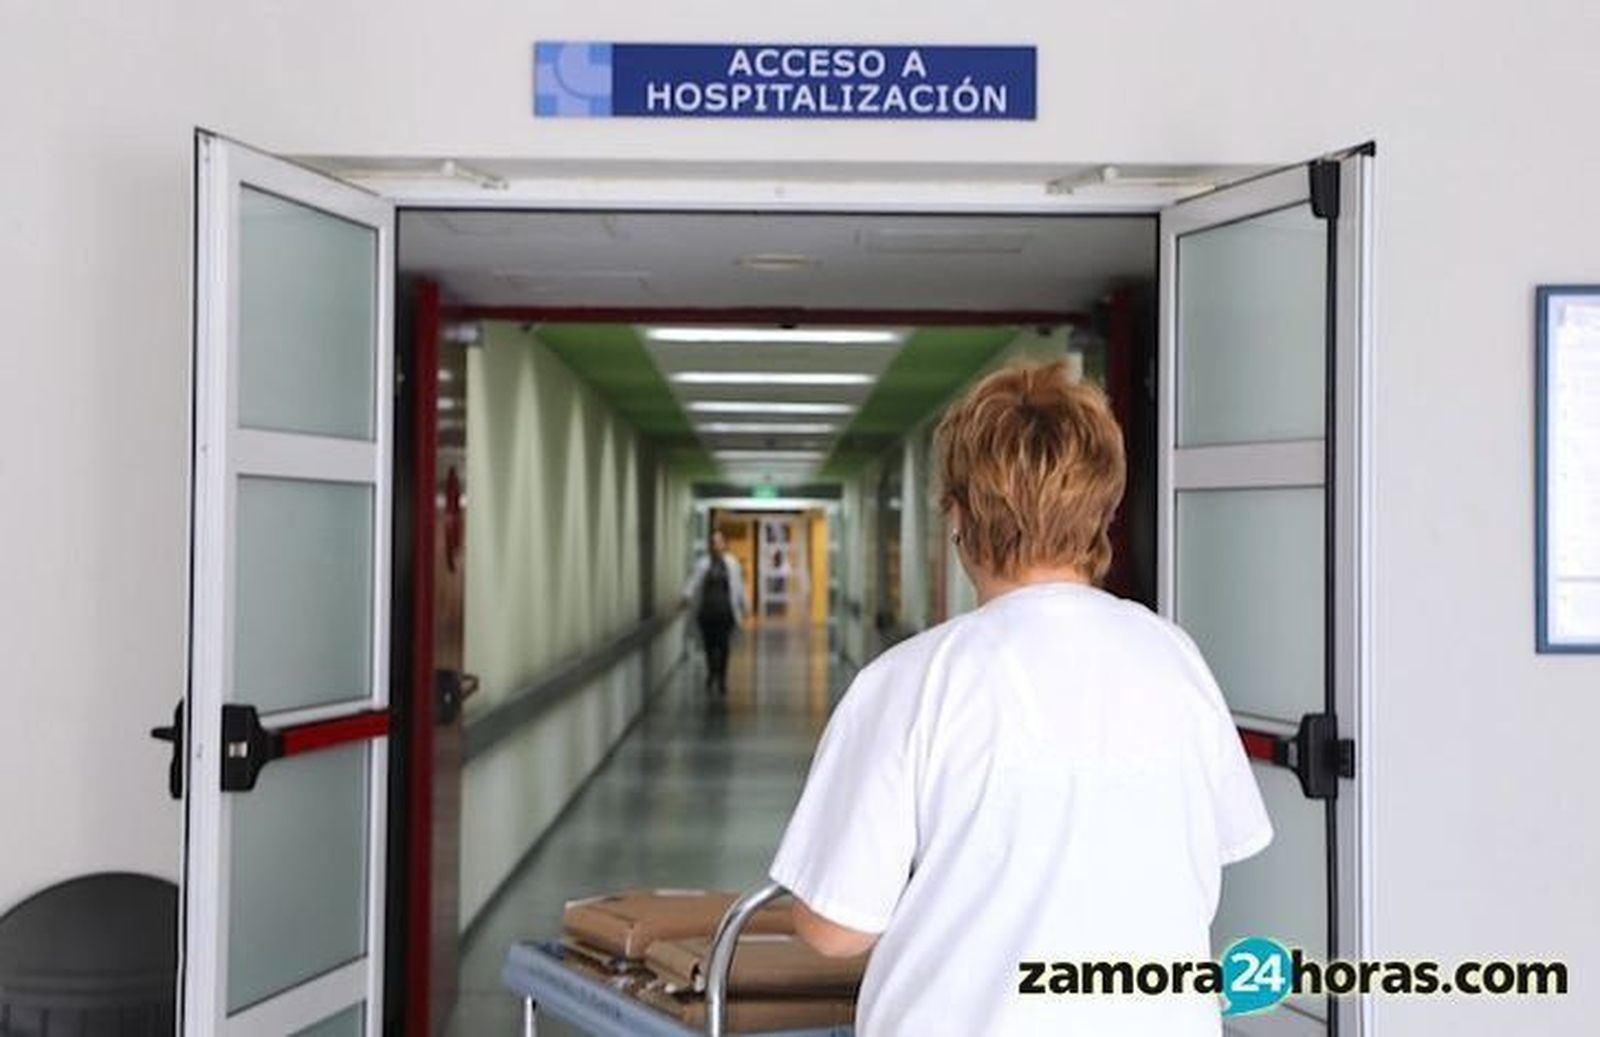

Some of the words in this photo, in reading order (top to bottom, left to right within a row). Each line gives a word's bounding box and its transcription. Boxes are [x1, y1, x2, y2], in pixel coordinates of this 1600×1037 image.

[728, 49, 886, 77] ACCESO
[902, 50, 926, 78] A
[647, 78, 1007, 112] HOSPITALIZACIÓN
